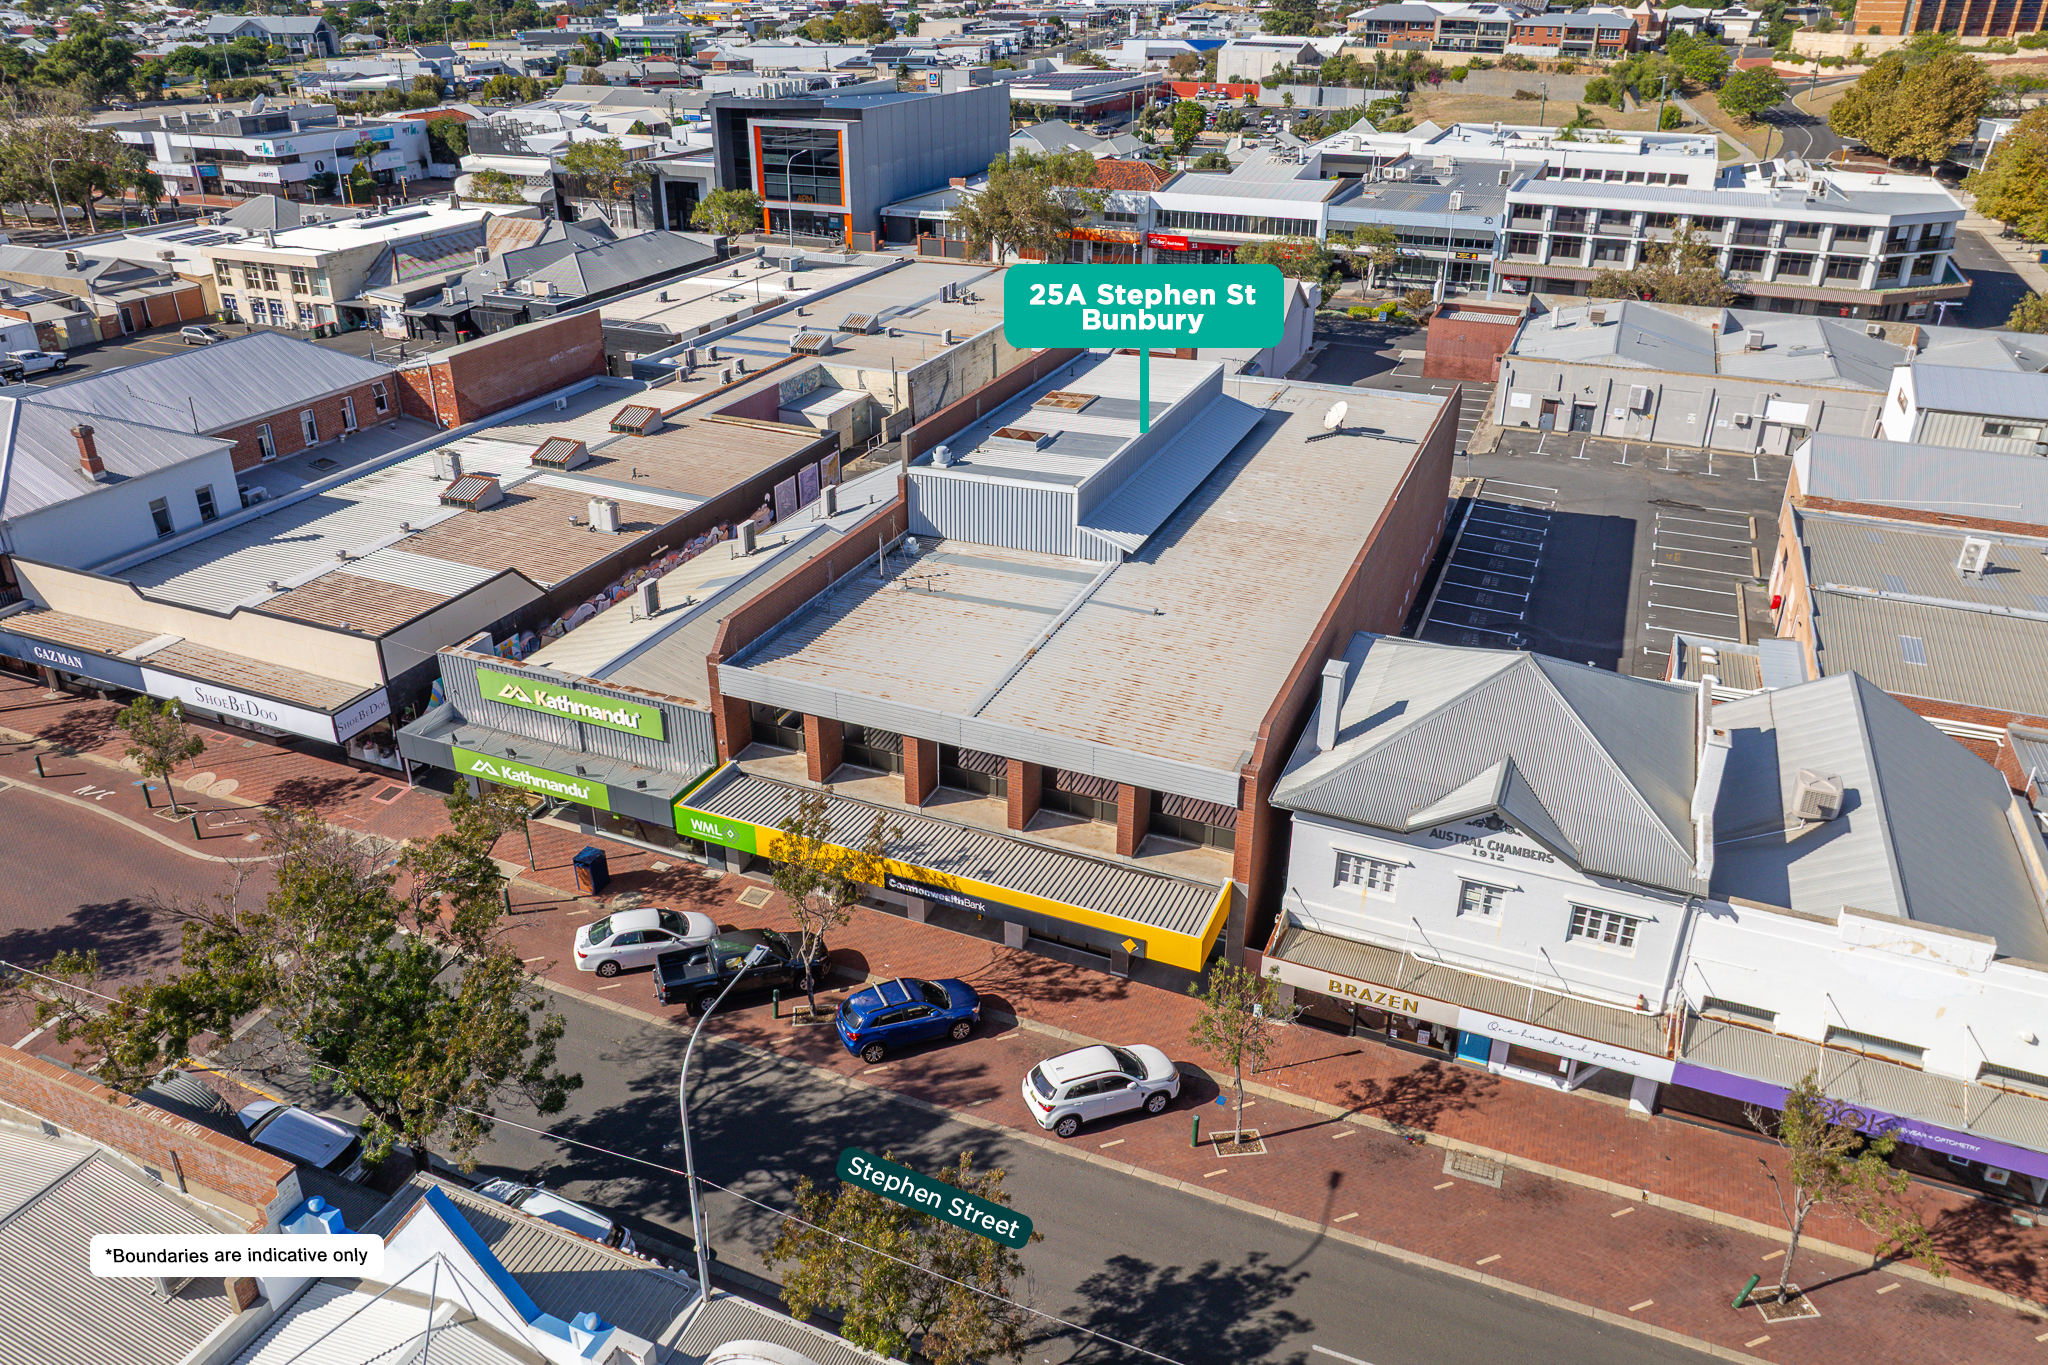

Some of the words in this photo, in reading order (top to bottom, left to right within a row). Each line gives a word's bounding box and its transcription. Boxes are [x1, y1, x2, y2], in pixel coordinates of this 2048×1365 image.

[797, 195, 813, 203] APM
[33, 646, 83, 668] GAZMAN
[690, 818, 723, 836] WML
[1428, 828, 1484, 849] AUSTRAL
[1487, 840, 1555, 864] CHAMBERS
[1472, 848, 1505, 862] 1912
[1328, 979, 1419, 1014] BRAZEN
[1487, 1021, 1518, 1035] One
[1521, 1029, 1591, 1054] hundred
[1593, 1051, 1641, 1066] years
[1934, 1136, 1980, 1151] OPTOMETRY
